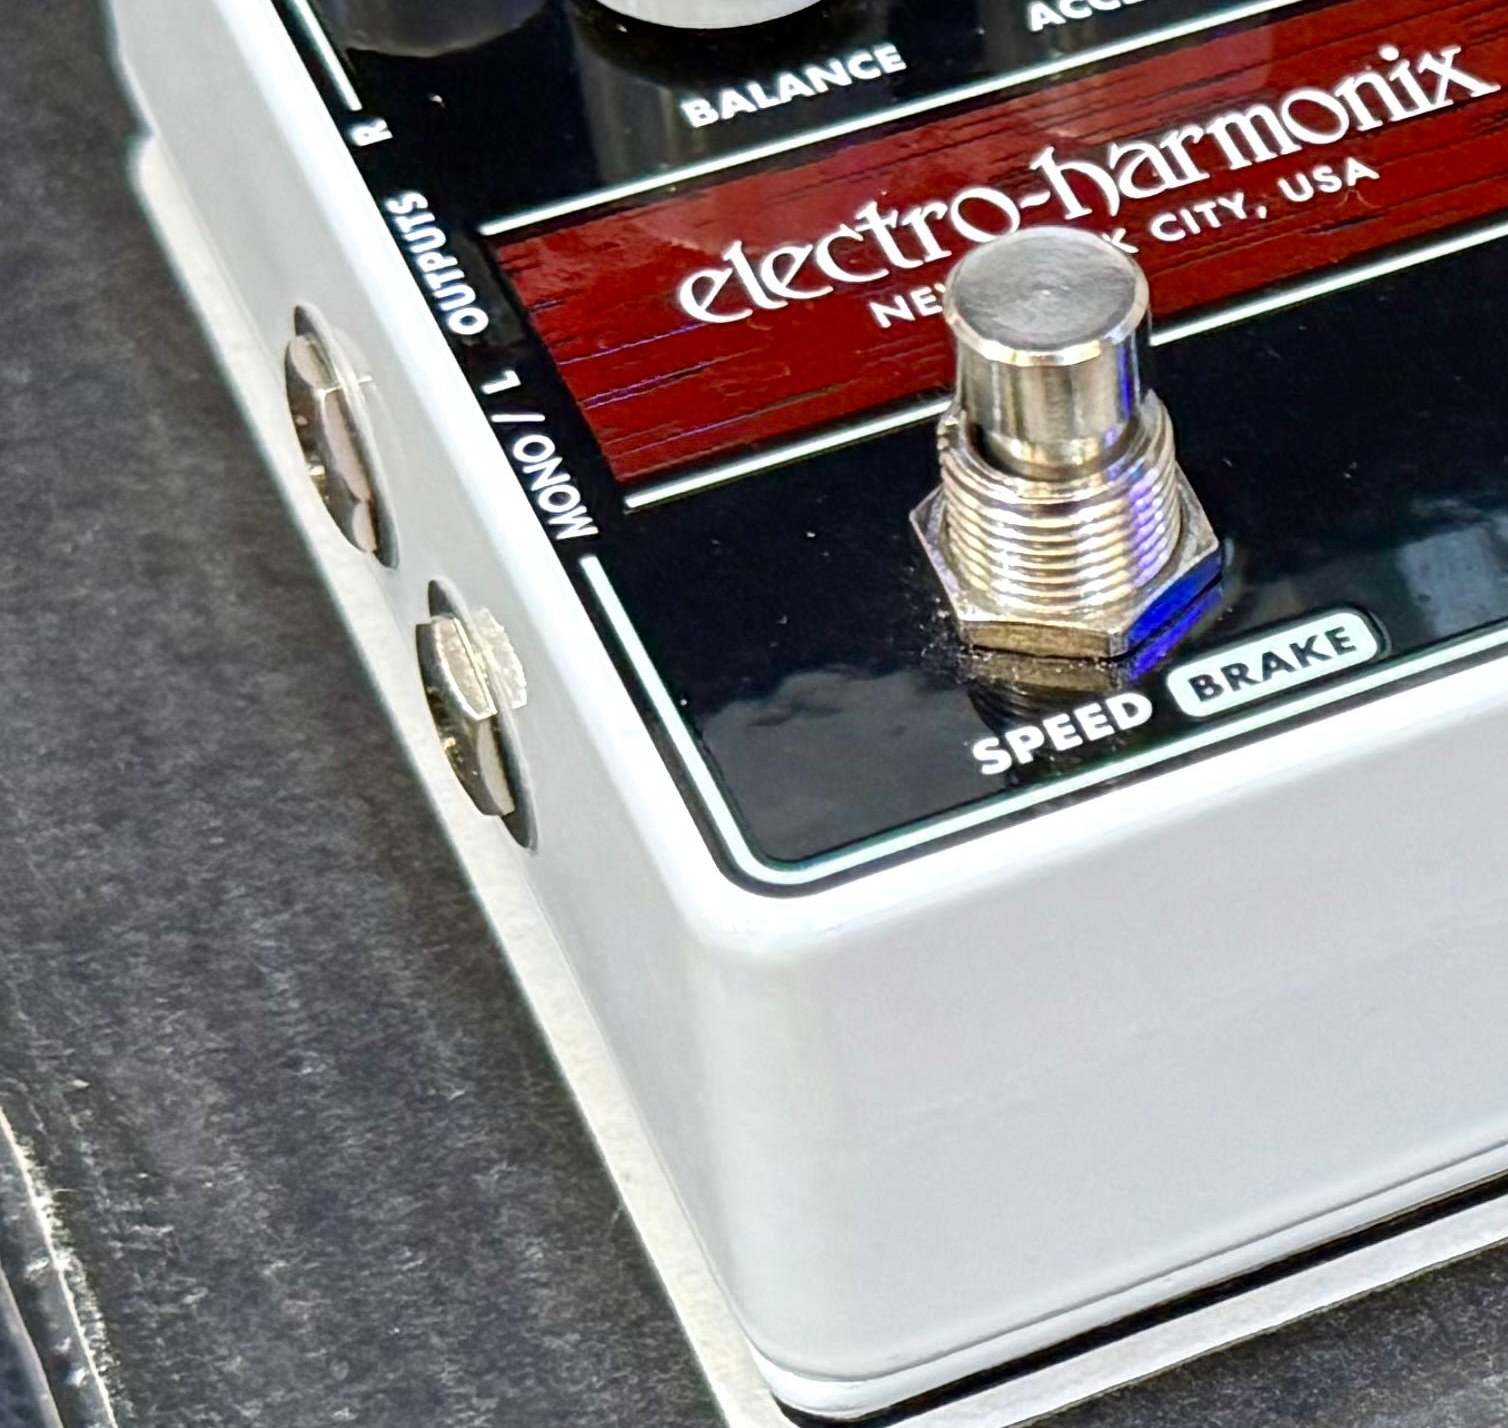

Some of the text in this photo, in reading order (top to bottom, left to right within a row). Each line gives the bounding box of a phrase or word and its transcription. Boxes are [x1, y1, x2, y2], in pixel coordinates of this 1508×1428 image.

[349, 117, 394, 147] R
[679, 42, 908, 130] BALANCE
[674, 45, 1502, 326] electro-harmonix
[386, 189, 490, 337] OUTPUTS
[868, 280, 945, 329] NE
[1148, 190, 1269, 245] CITY,
[1282, 155, 1381, 204] USA
[511, 433, 600, 541] MONO
[1187, 626, 1357, 703] BRAKE
[971, 689, 1157, 777] SPEED
